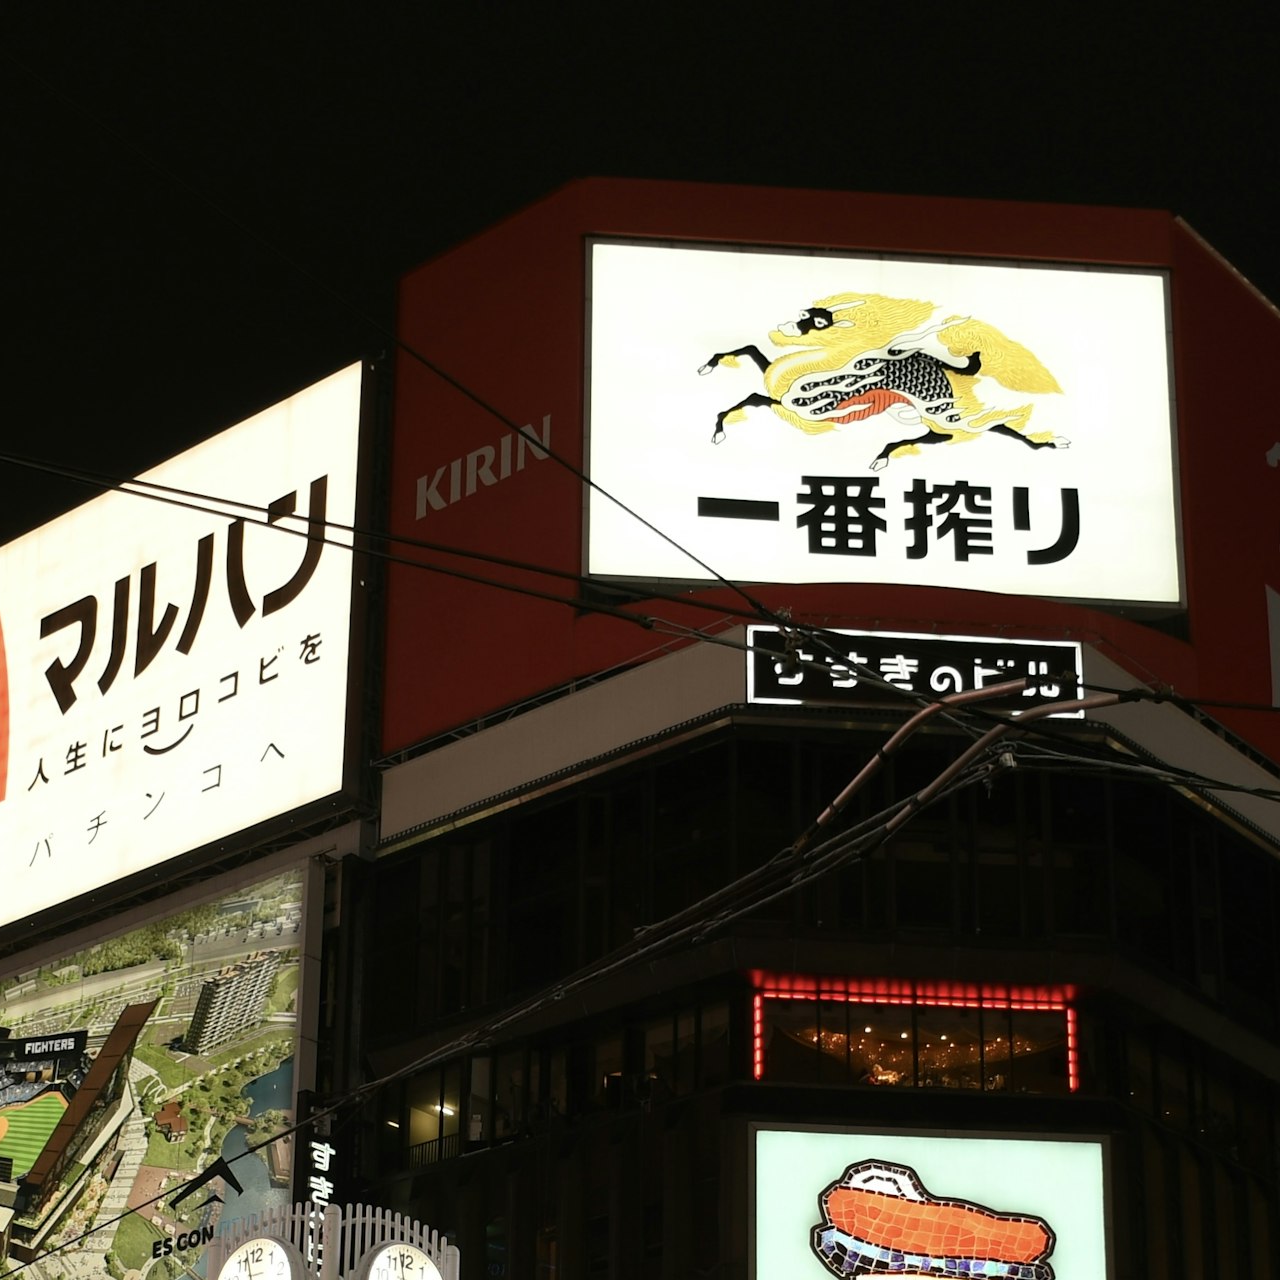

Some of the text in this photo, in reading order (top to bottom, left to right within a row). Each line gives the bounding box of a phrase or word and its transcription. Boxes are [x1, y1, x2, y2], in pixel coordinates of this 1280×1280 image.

[415, 414, 553, 521] KIRIN
[698, 474, 1083, 566] 一番搾り
[39, 474, 328, 715] マルハン
[27, 634, 324, 792] 人生にヨロコビを
[24, 1037, 76, 1056] FIGHTERS
[250, 1248, 263, 1263] 12
